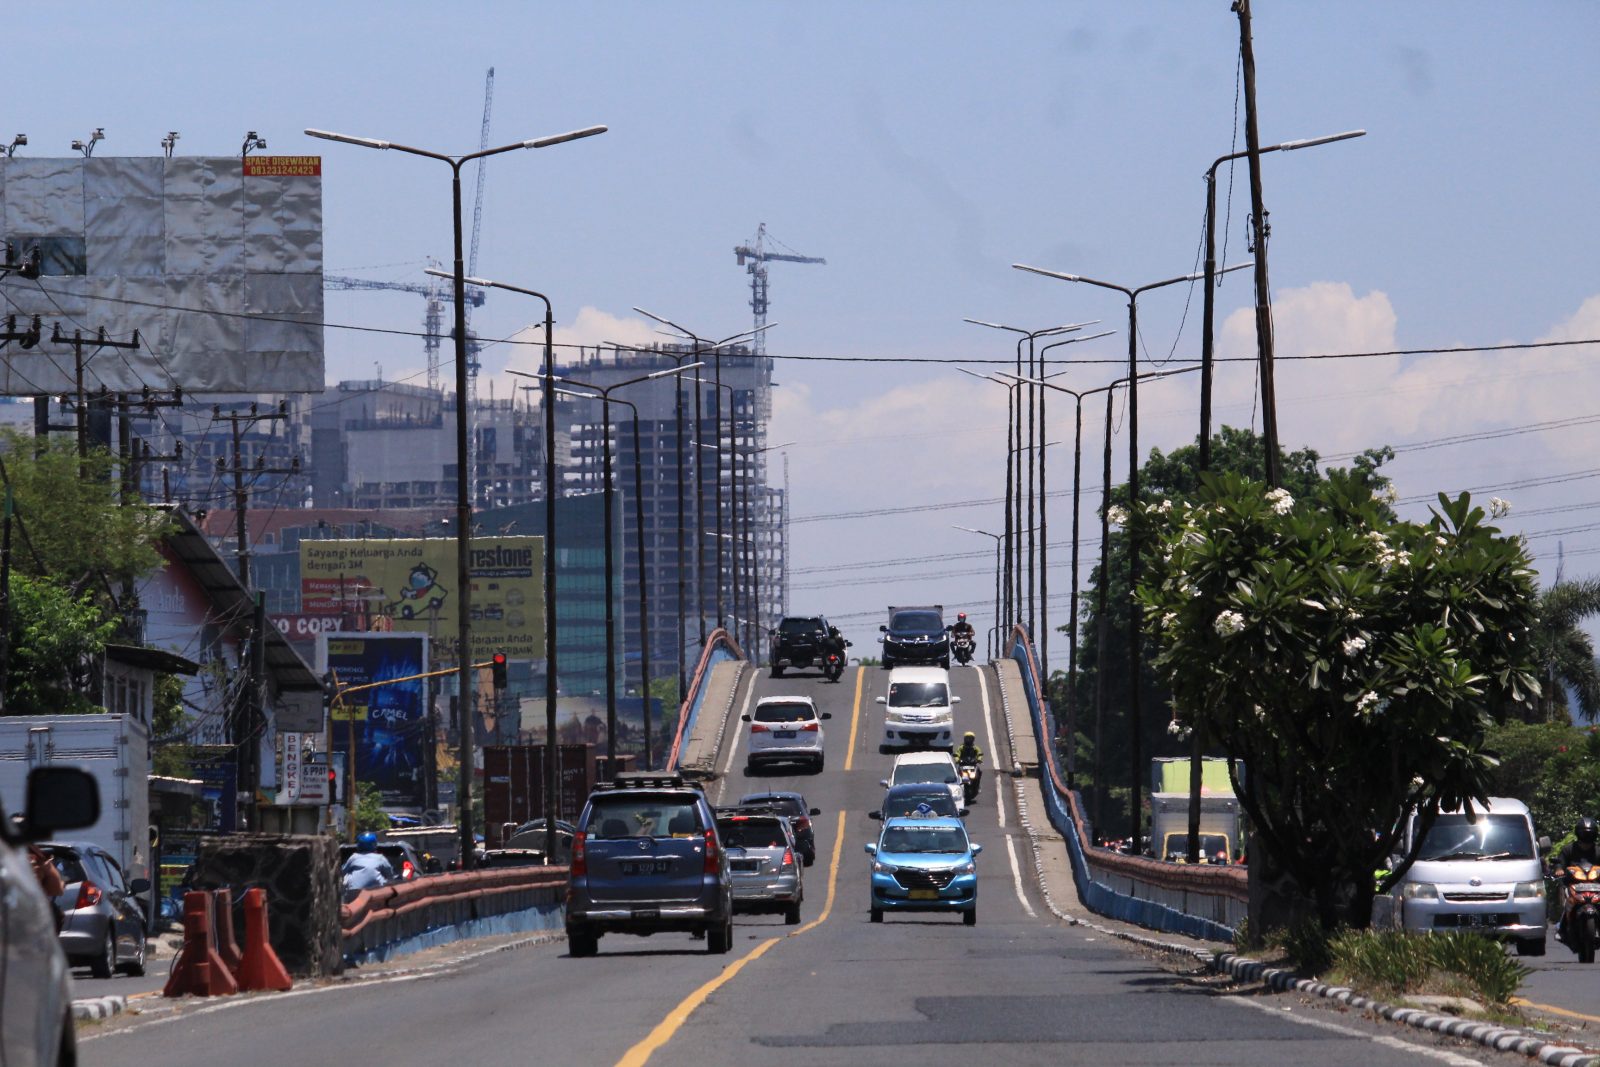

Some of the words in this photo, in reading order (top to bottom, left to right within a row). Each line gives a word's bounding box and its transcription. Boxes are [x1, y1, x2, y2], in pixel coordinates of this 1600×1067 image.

[246, 157, 270, 165] SPACE
[272, 157, 319, 165] DISEWAKAN
[307, 548, 348, 560] Sayangi
[350, 548, 394, 560] Keluarga
[397, 547, 423, 557] Anda
[469, 545, 532, 567] restone
[307, 560, 346, 572] dengan
[348, 560, 363, 569] 3M
[297, 618, 343, 634] COPY
[507, 634, 533, 643] Anda
[372, 708, 408, 721] CAMEL
[287, 735, 298, 798] BENGKEL
